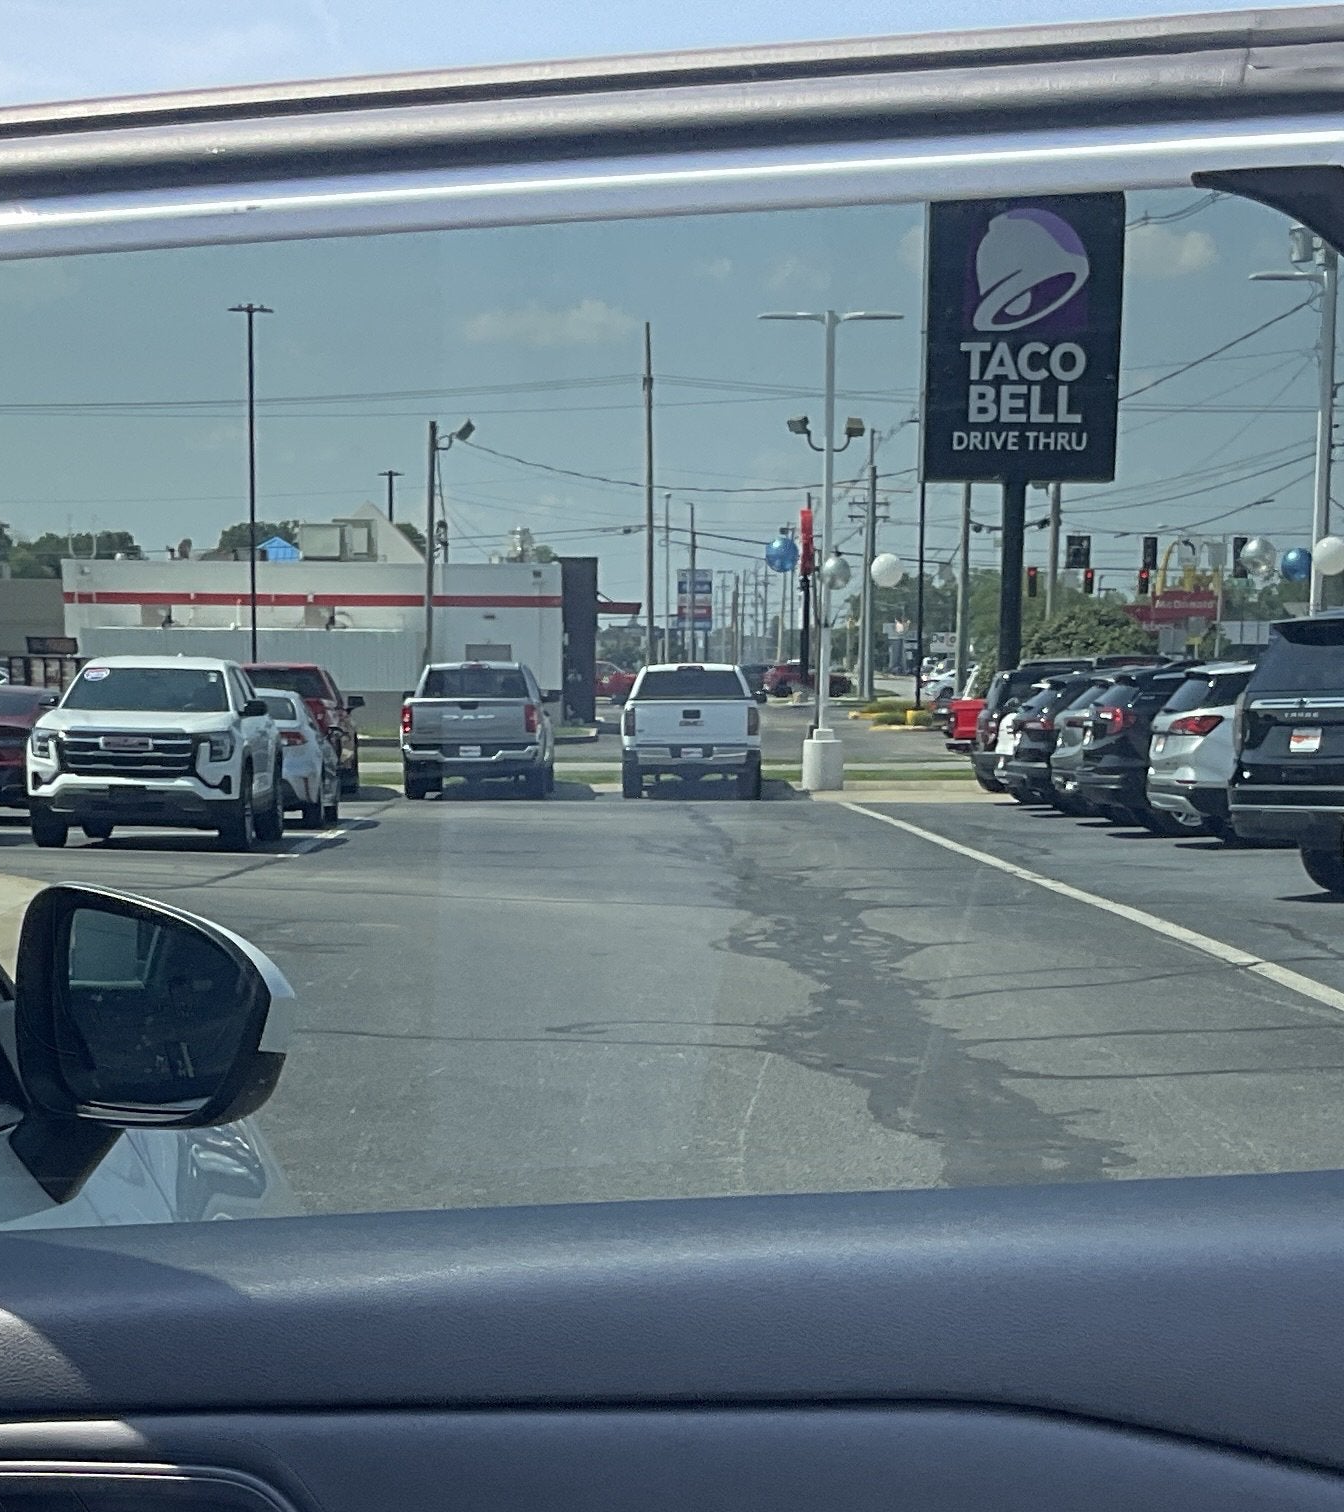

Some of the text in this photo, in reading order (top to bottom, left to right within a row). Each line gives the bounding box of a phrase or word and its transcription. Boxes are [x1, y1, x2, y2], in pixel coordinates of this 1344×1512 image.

[959, 341, 1087, 382] TACO
[967, 384, 1082, 423] BELL
[952, 431, 1088, 451] DRIVE THRU
